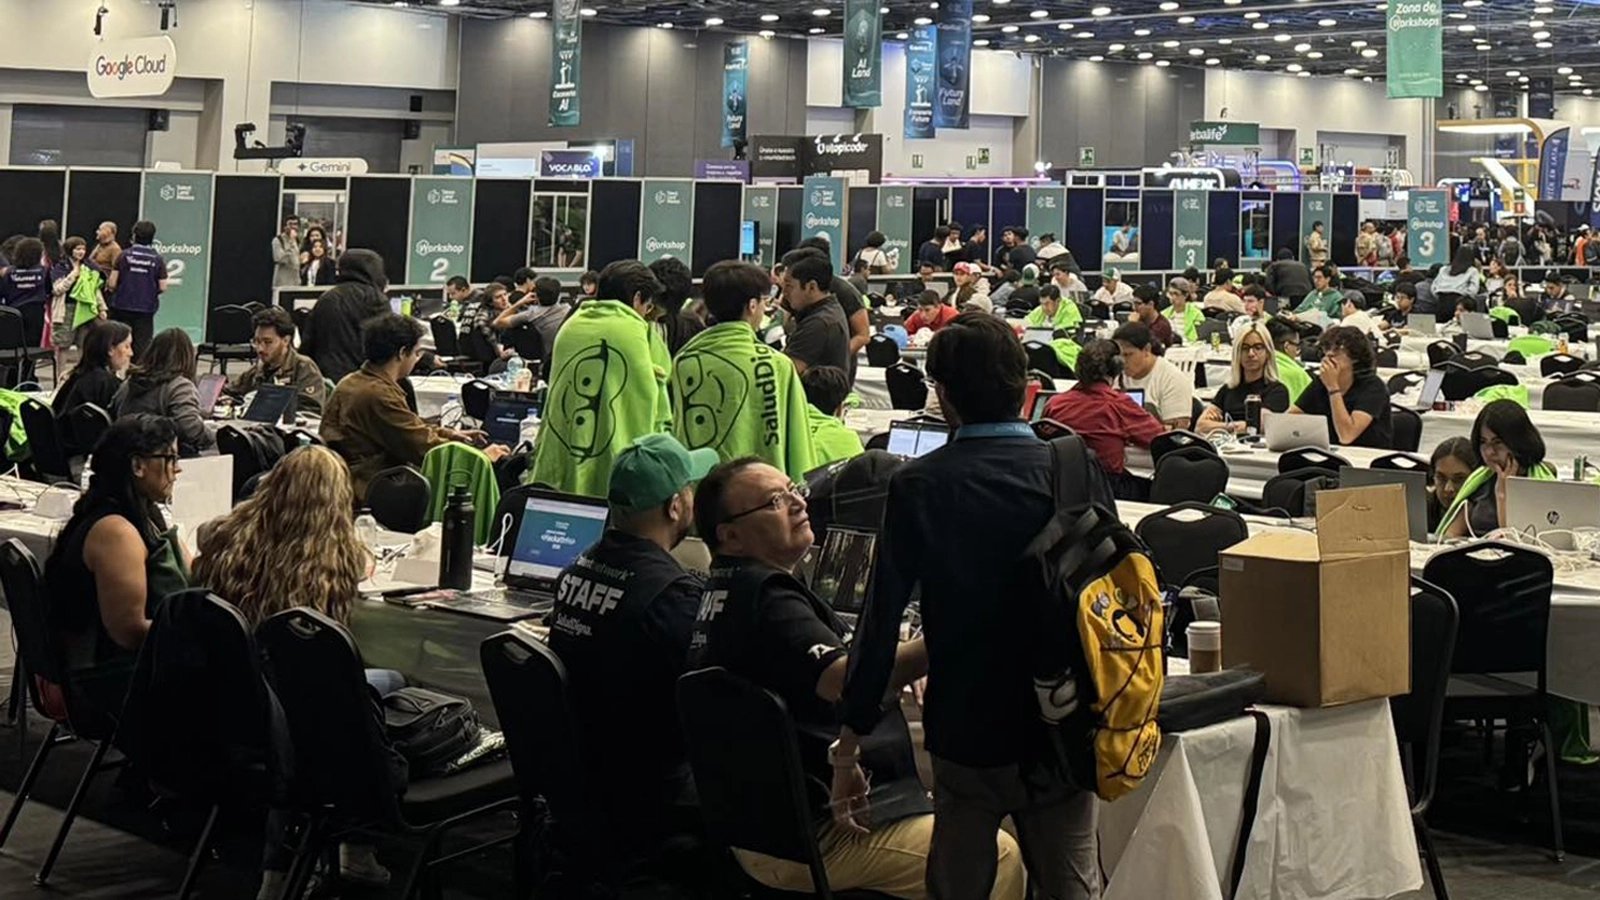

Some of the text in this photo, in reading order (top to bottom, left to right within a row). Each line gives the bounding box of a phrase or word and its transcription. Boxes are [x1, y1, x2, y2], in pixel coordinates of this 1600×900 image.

[1396, 1, 1436, 14] Zona de
[1389, 14, 1440, 32] Workshops
[96, 53, 167, 80] Google Cloud
[857, 59, 867, 68] AI
[851, 68, 872, 78] Land
[310, 161, 351, 173] Gemini
[806, 213, 840, 229] Workshop
[416, 239, 465, 257] Workshop
[646, 237, 686, 253] Workshop
[1418, 231, 1435, 257] 3
[1185, 248, 1196, 266] 3
[166, 259, 186, 285] 2
[430, 258, 449, 281] 2
[558, 573, 624, 615] STAFF
